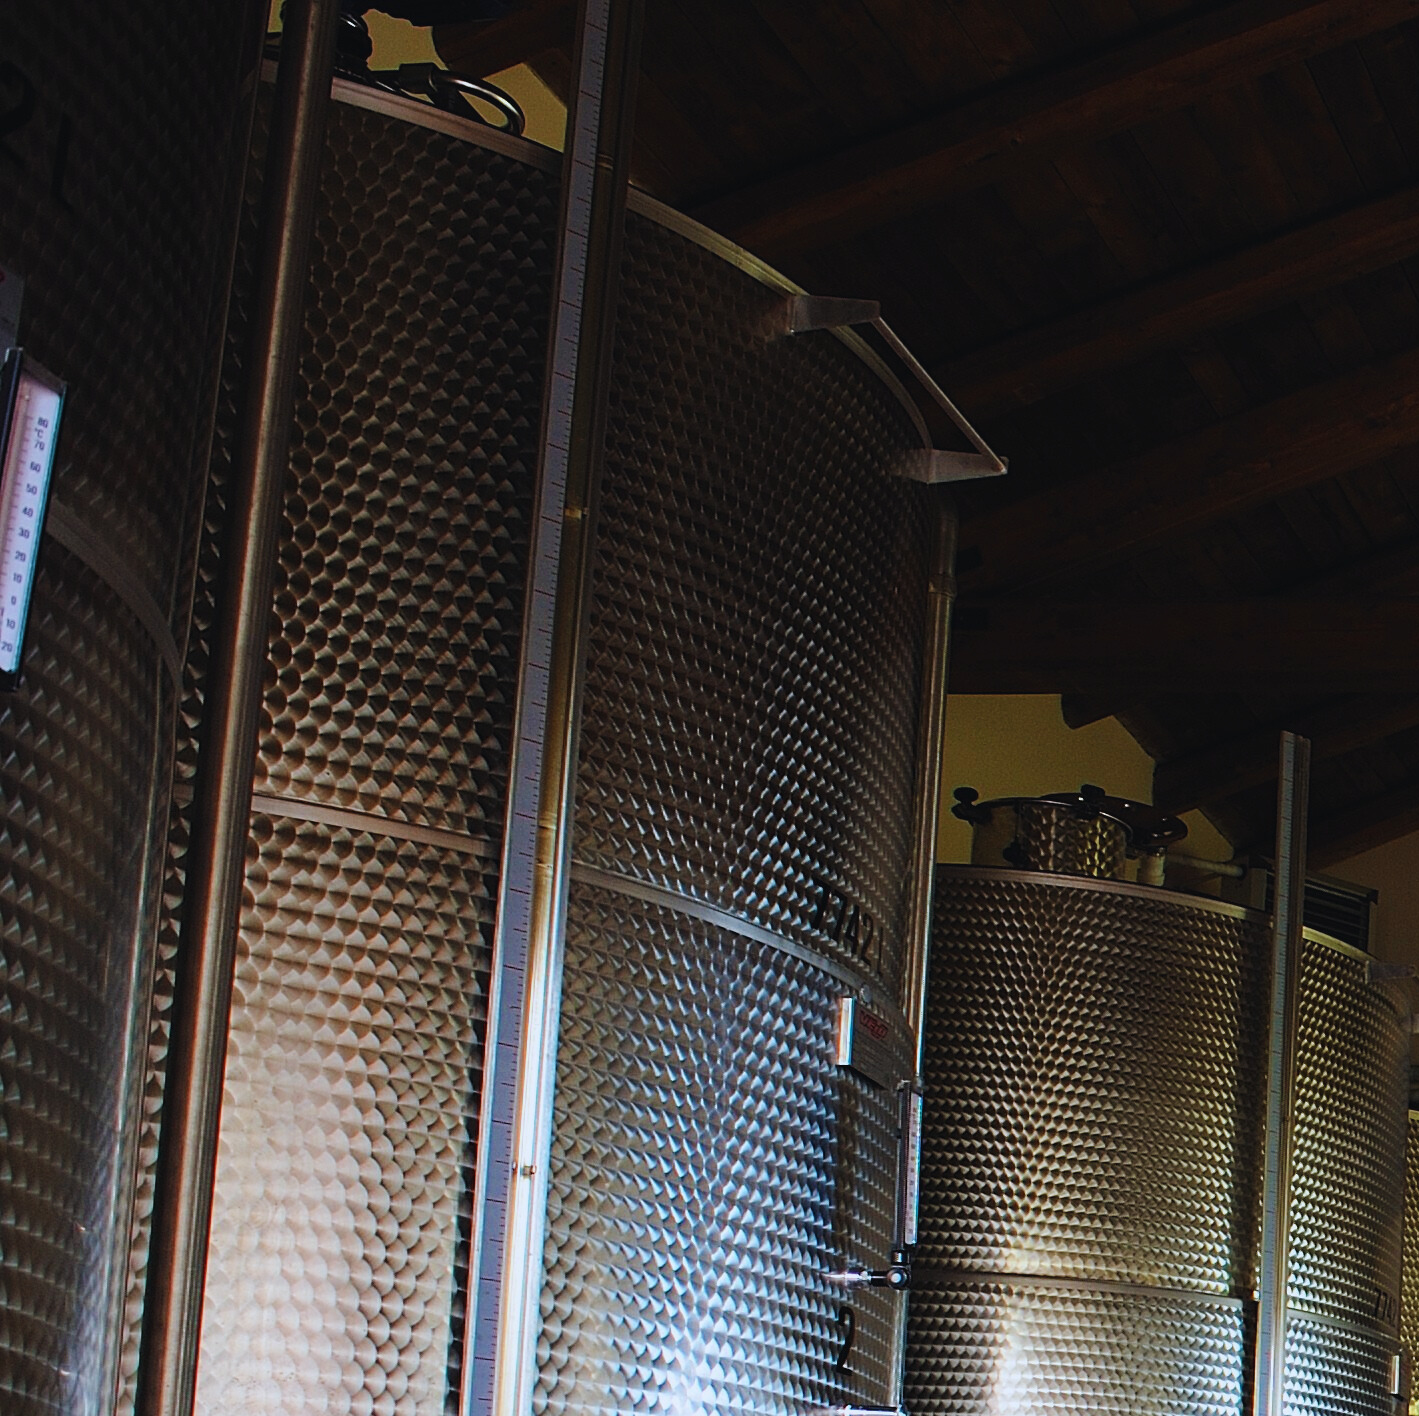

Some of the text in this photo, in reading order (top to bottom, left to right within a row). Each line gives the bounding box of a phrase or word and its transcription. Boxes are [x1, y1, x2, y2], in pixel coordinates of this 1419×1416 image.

[35, 441, 45, 451] 70
[30, 461, 41, 473] 60
[26, 483, 38, 496] 50
[22, 506, 34, 518] 40
[18, 527, 30, 539] 30
[14, 550, 26, 562] 20
[13, 572, 22, 584] 10
[10, 595, 17, 606] 0
[6, 618, 16, 630] 10
[1, 641, 13, 653] 20
[811, 875, 874, 967] 7742
[836, 1306, 855, 1377] 2
